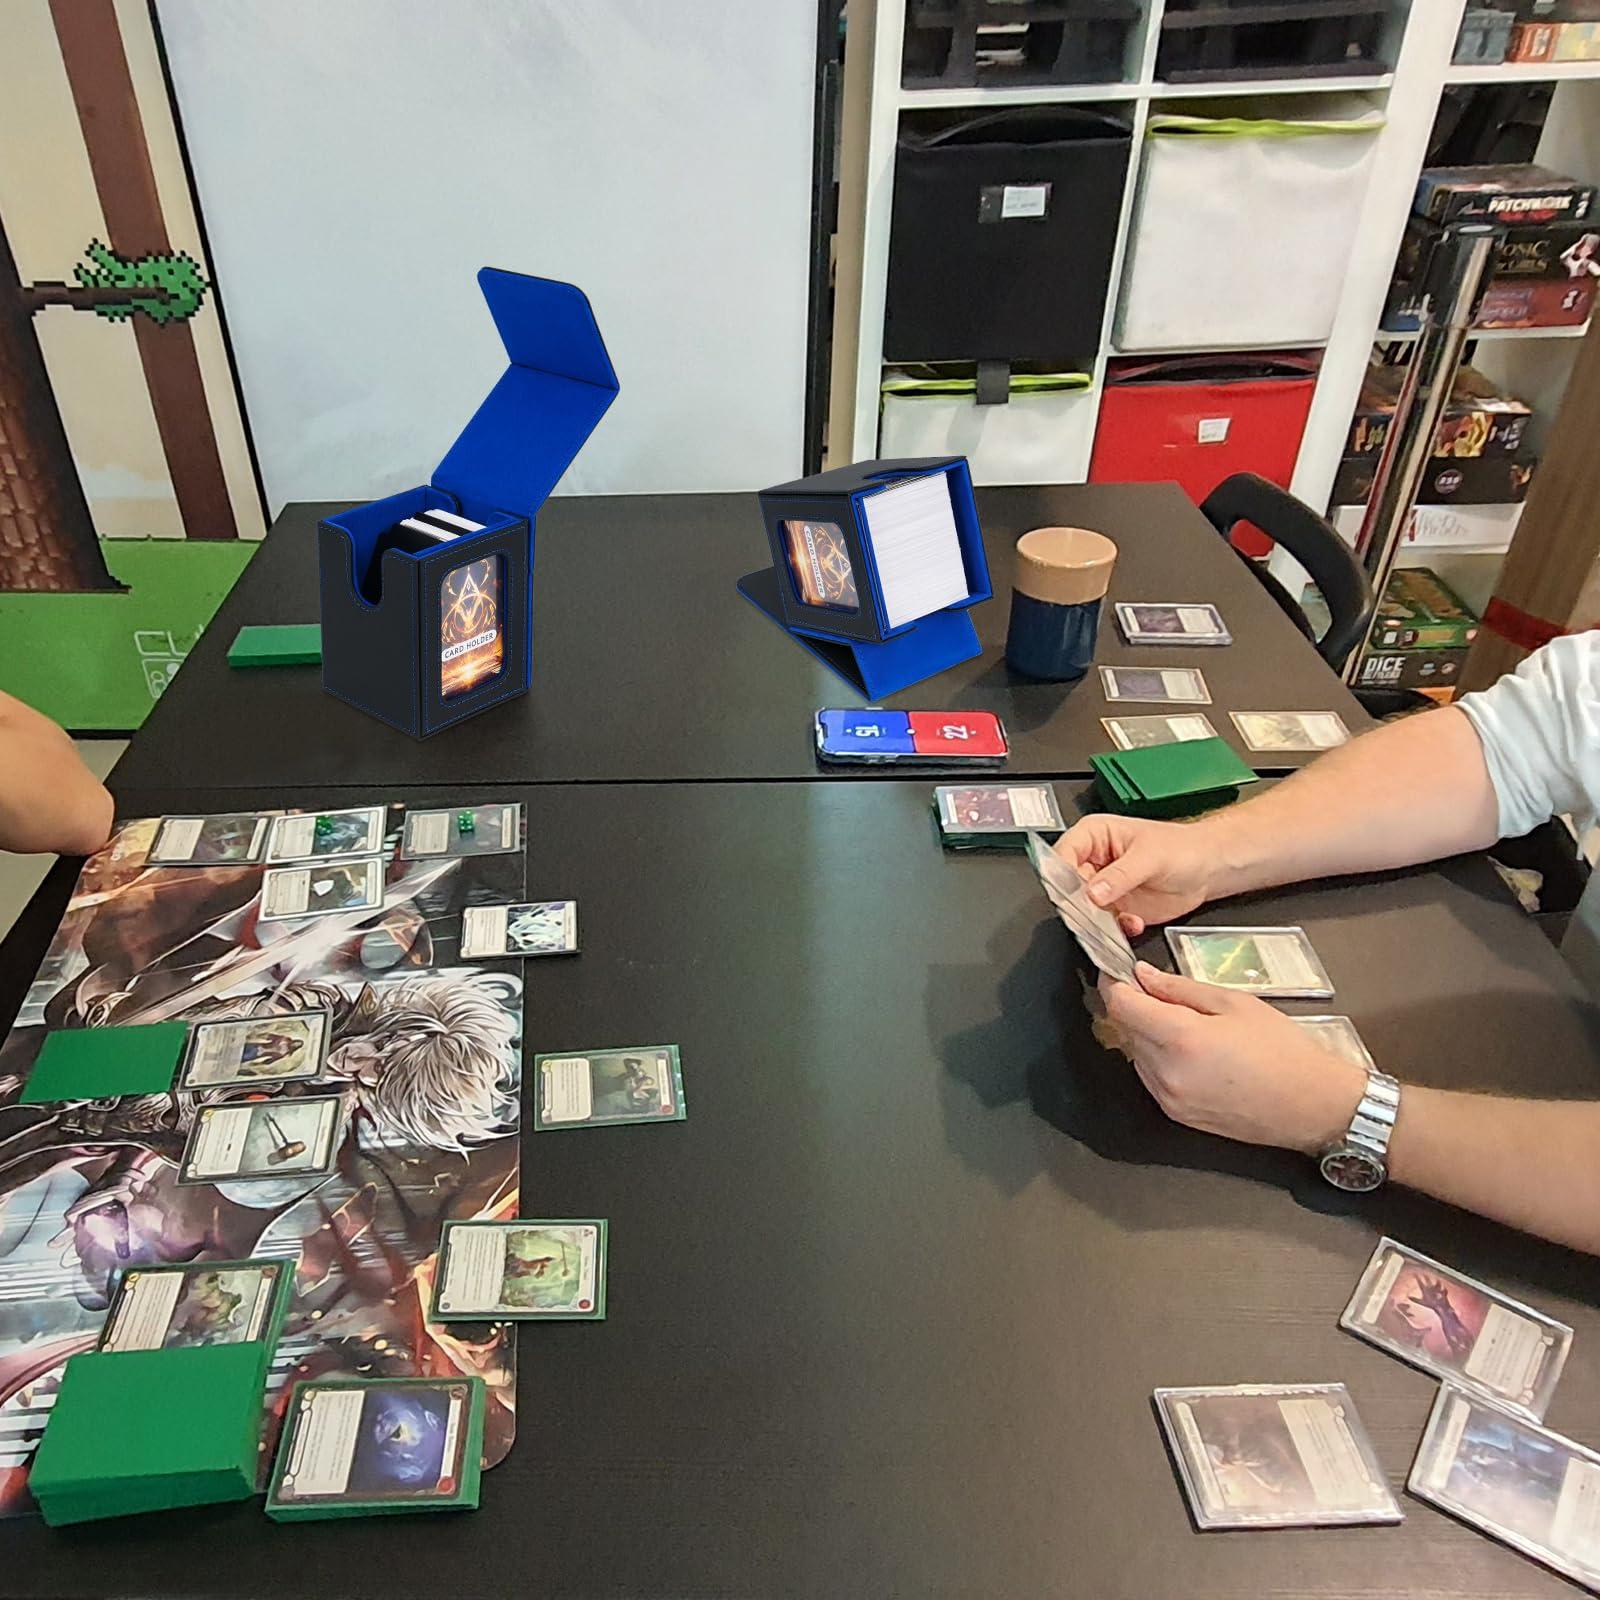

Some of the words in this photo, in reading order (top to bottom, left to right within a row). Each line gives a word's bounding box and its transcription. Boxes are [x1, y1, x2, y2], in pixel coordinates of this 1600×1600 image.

[805, 529, 815, 555] CARD
[811, 557, 825, 594] HOLDER
[444, 644, 465, 659] CARD
[466, 632, 494, 650] HOLDER
[1364, 656, 1407, 673] DICE
[855, 725, 880, 738] 15
[942, 725, 969, 740] 22
